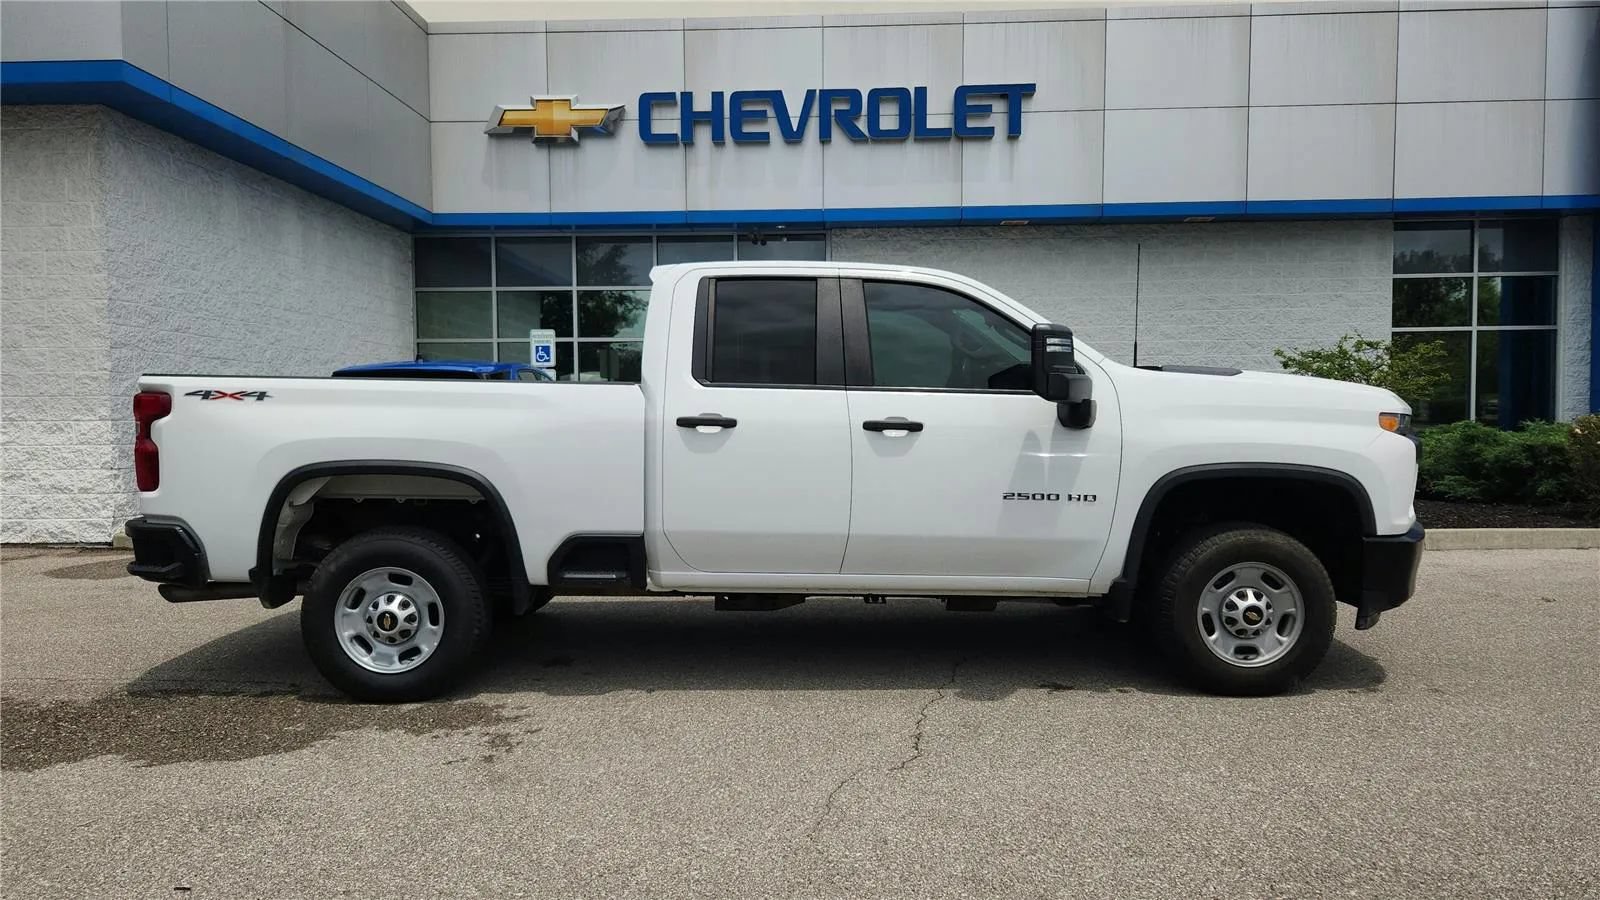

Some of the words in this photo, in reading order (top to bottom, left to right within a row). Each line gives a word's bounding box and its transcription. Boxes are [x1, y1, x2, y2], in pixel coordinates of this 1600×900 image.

[638, 83, 1036, 145] CHEVROLET
[1002, 492, 1060, 502] 2500
[1067, 493, 1097, 503] HD
